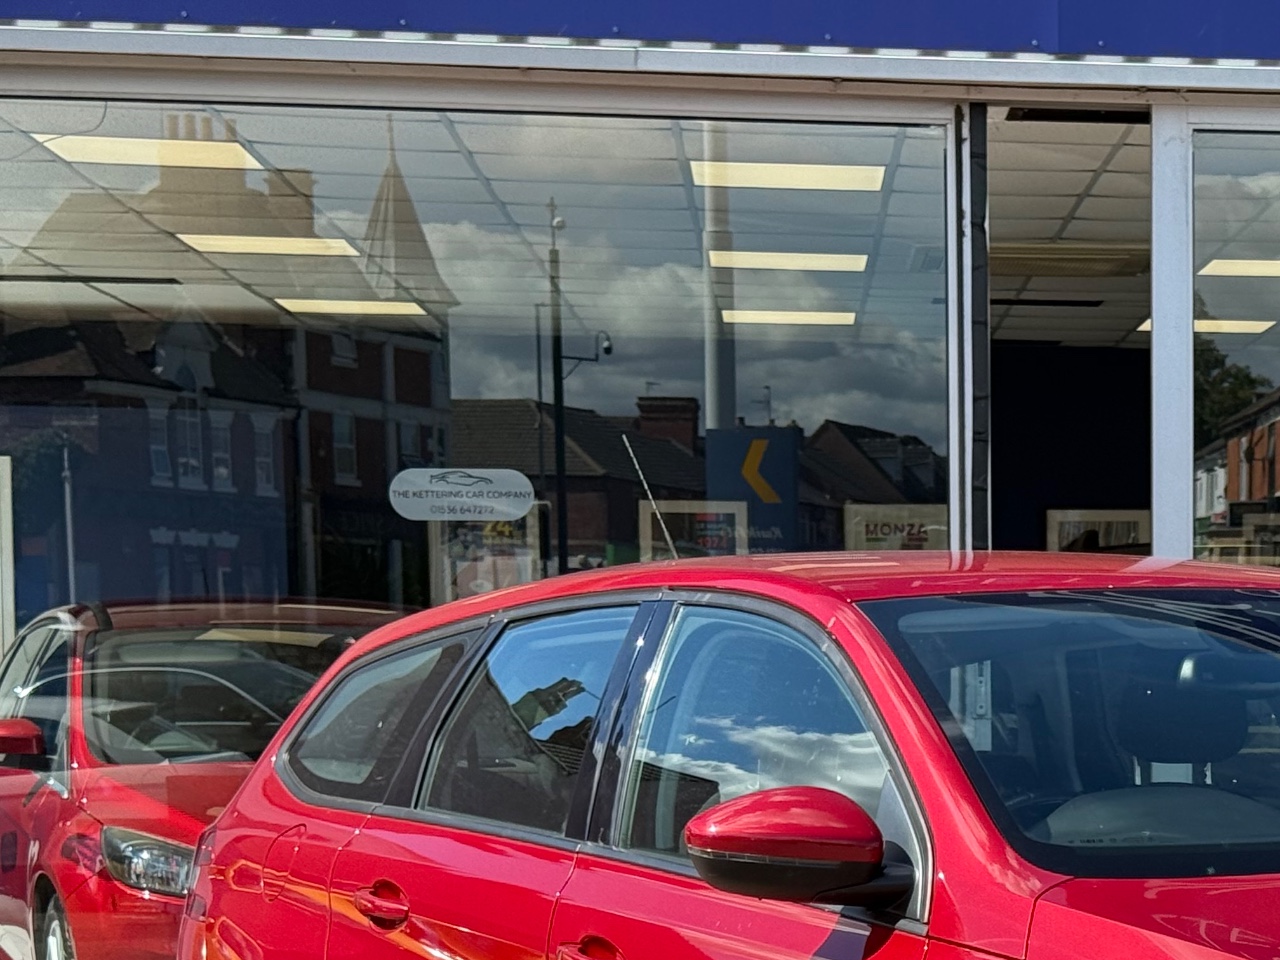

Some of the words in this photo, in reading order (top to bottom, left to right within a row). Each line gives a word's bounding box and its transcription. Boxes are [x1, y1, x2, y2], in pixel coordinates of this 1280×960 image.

[392, 490, 411, 499] THE
[412, 490, 464, 499] KETTERING
[465, 490, 485, 499] CAR
[486, 490, 532, 499] COMPANY
[430, 505, 457, 514] 01536
[460, 505, 494, 514] 647272
[865, 522, 929, 537] MONZA
